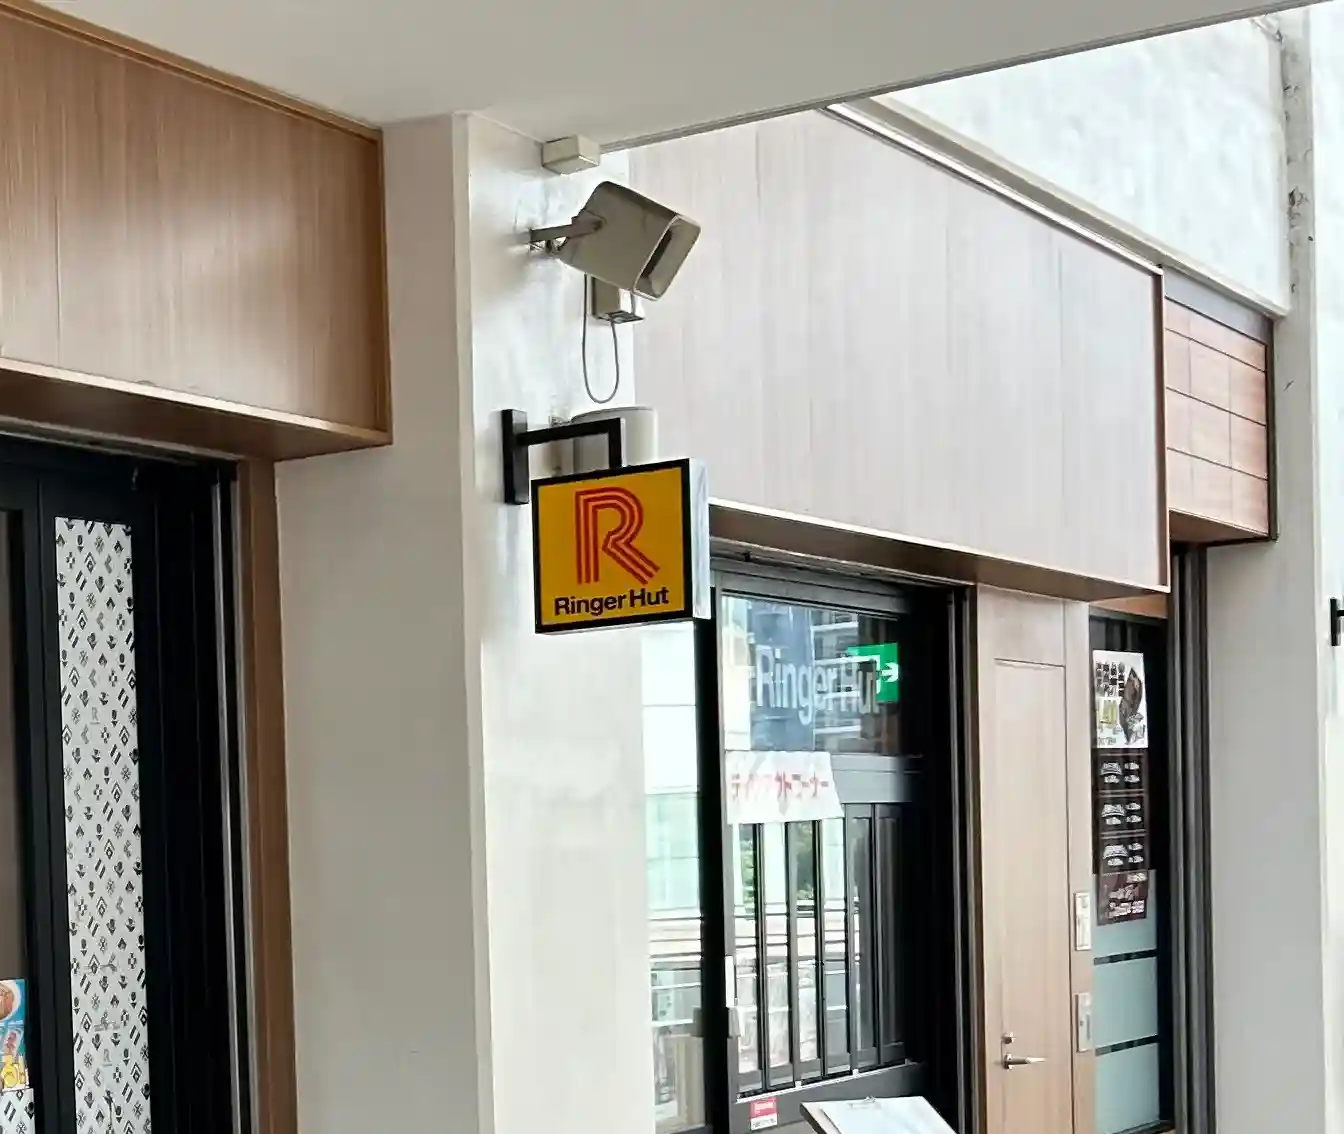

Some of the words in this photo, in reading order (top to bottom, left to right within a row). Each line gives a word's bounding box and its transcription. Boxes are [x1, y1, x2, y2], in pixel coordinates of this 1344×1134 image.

[575, 486, 661, 585] R
[555, 594, 630, 616] Ringer
[630, 586, 670, 608] Hut
[756, 645, 838, 726] Ringer
